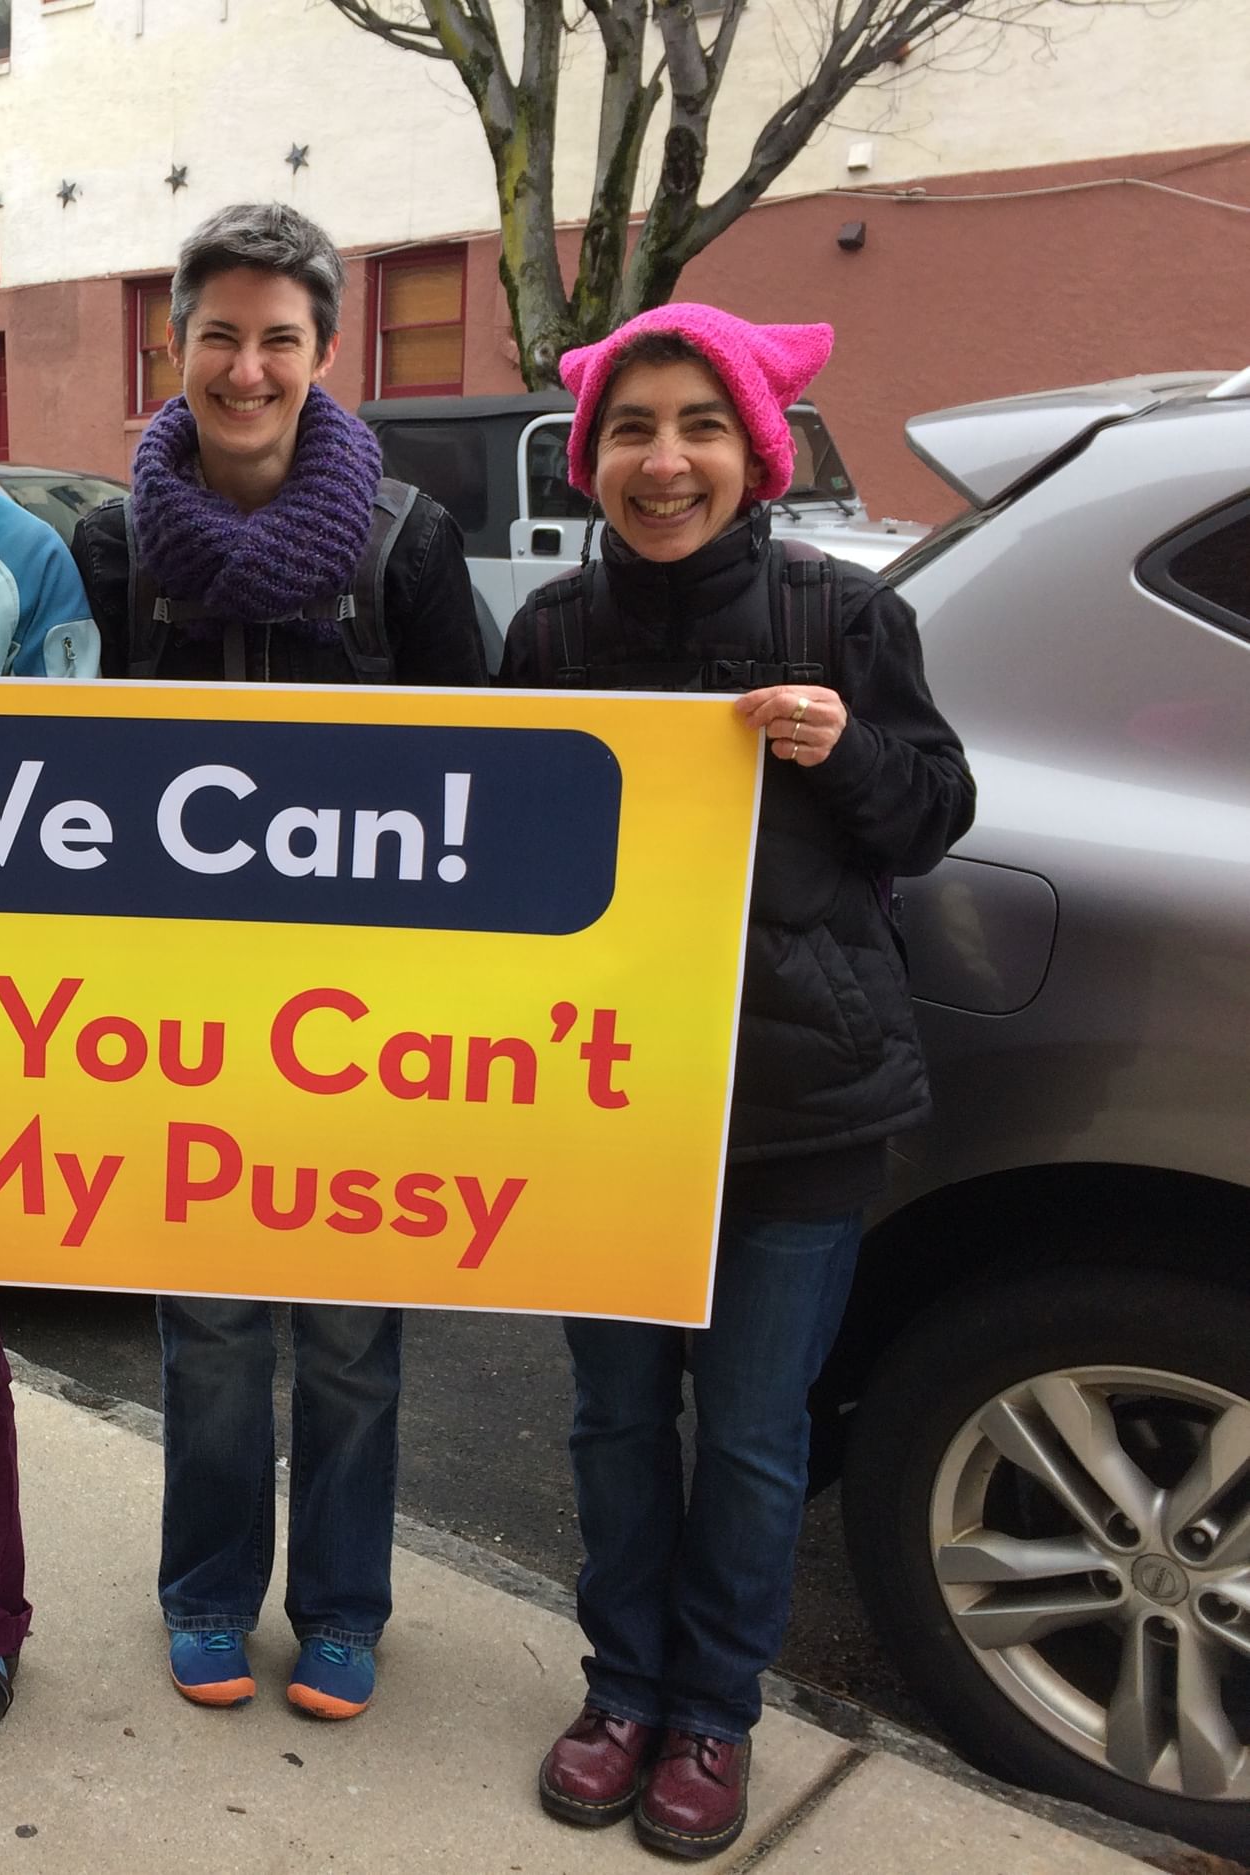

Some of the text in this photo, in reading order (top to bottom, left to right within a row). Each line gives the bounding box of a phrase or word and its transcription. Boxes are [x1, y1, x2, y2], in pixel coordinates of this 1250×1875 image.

[156, 764, 471, 883] Can!
[270, 987, 633, 1110] Can't
[164, 1121, 528, 1270] Pussy
